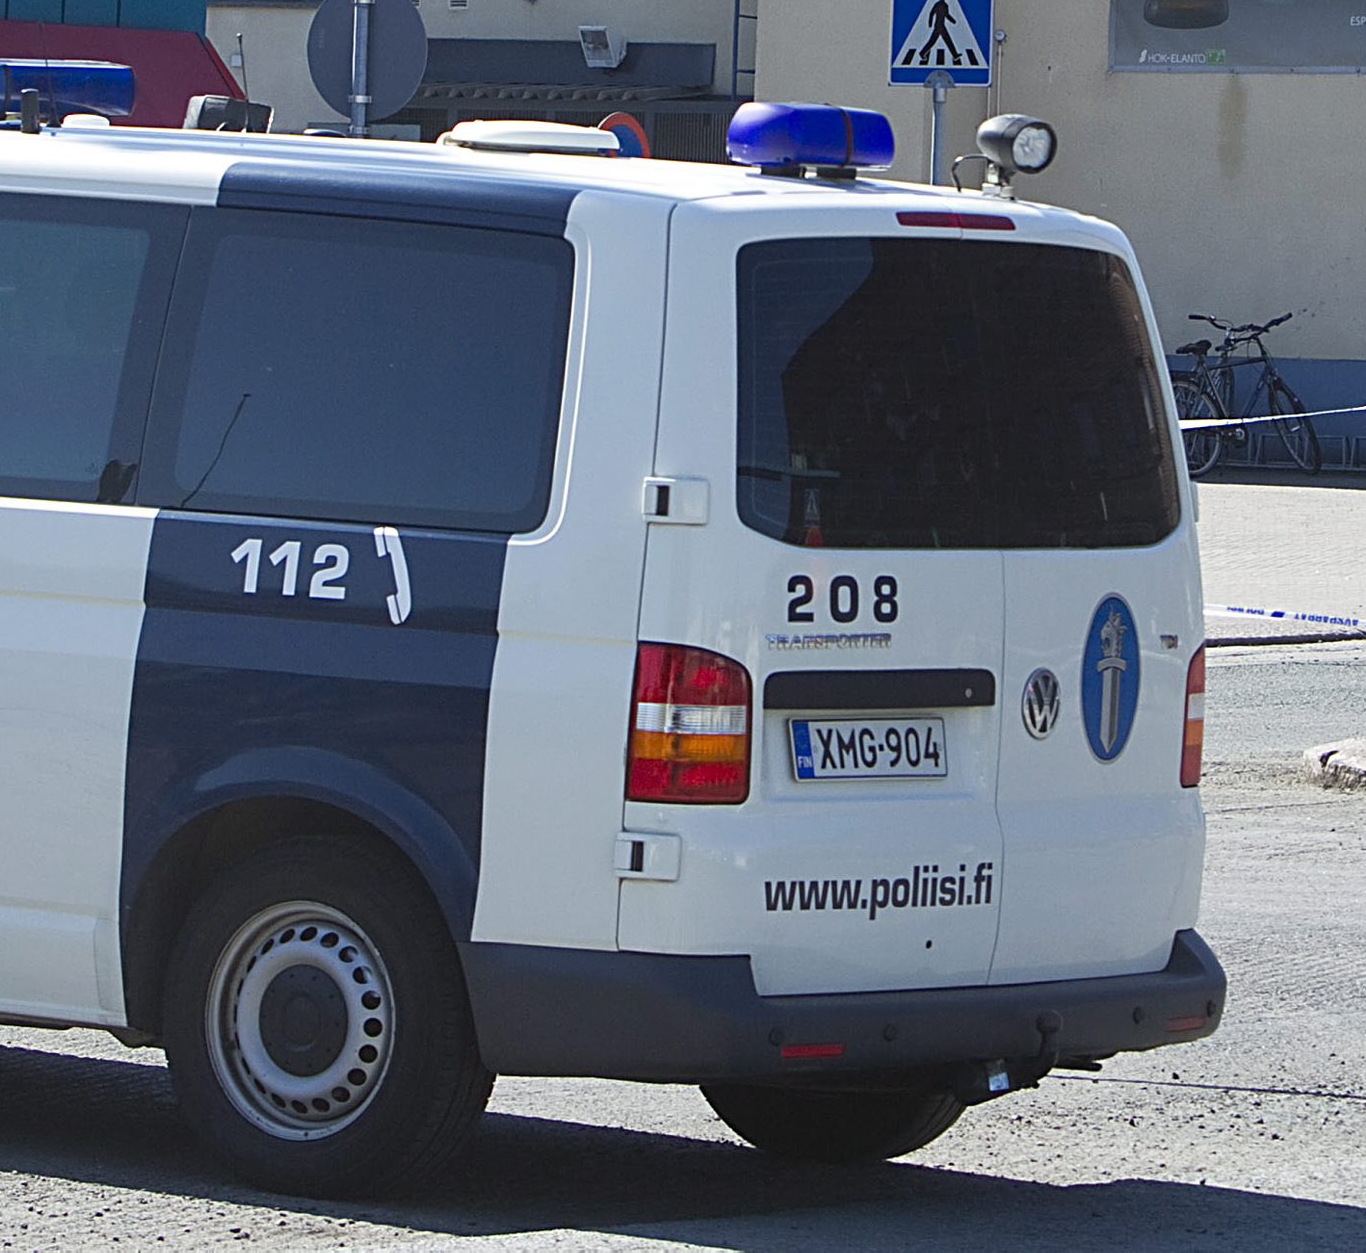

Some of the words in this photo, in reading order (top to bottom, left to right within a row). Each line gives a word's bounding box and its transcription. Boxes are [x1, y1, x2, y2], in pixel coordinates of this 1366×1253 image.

[1147, 53, 1206, 64] HOK-ELANTO
[230, 538, 350, 600] 112
[798, 755, 812, 769] FIN
[816, 727, 940, 769] XMG-904
[764, 862, 994, 921] www.poliisi.fi
